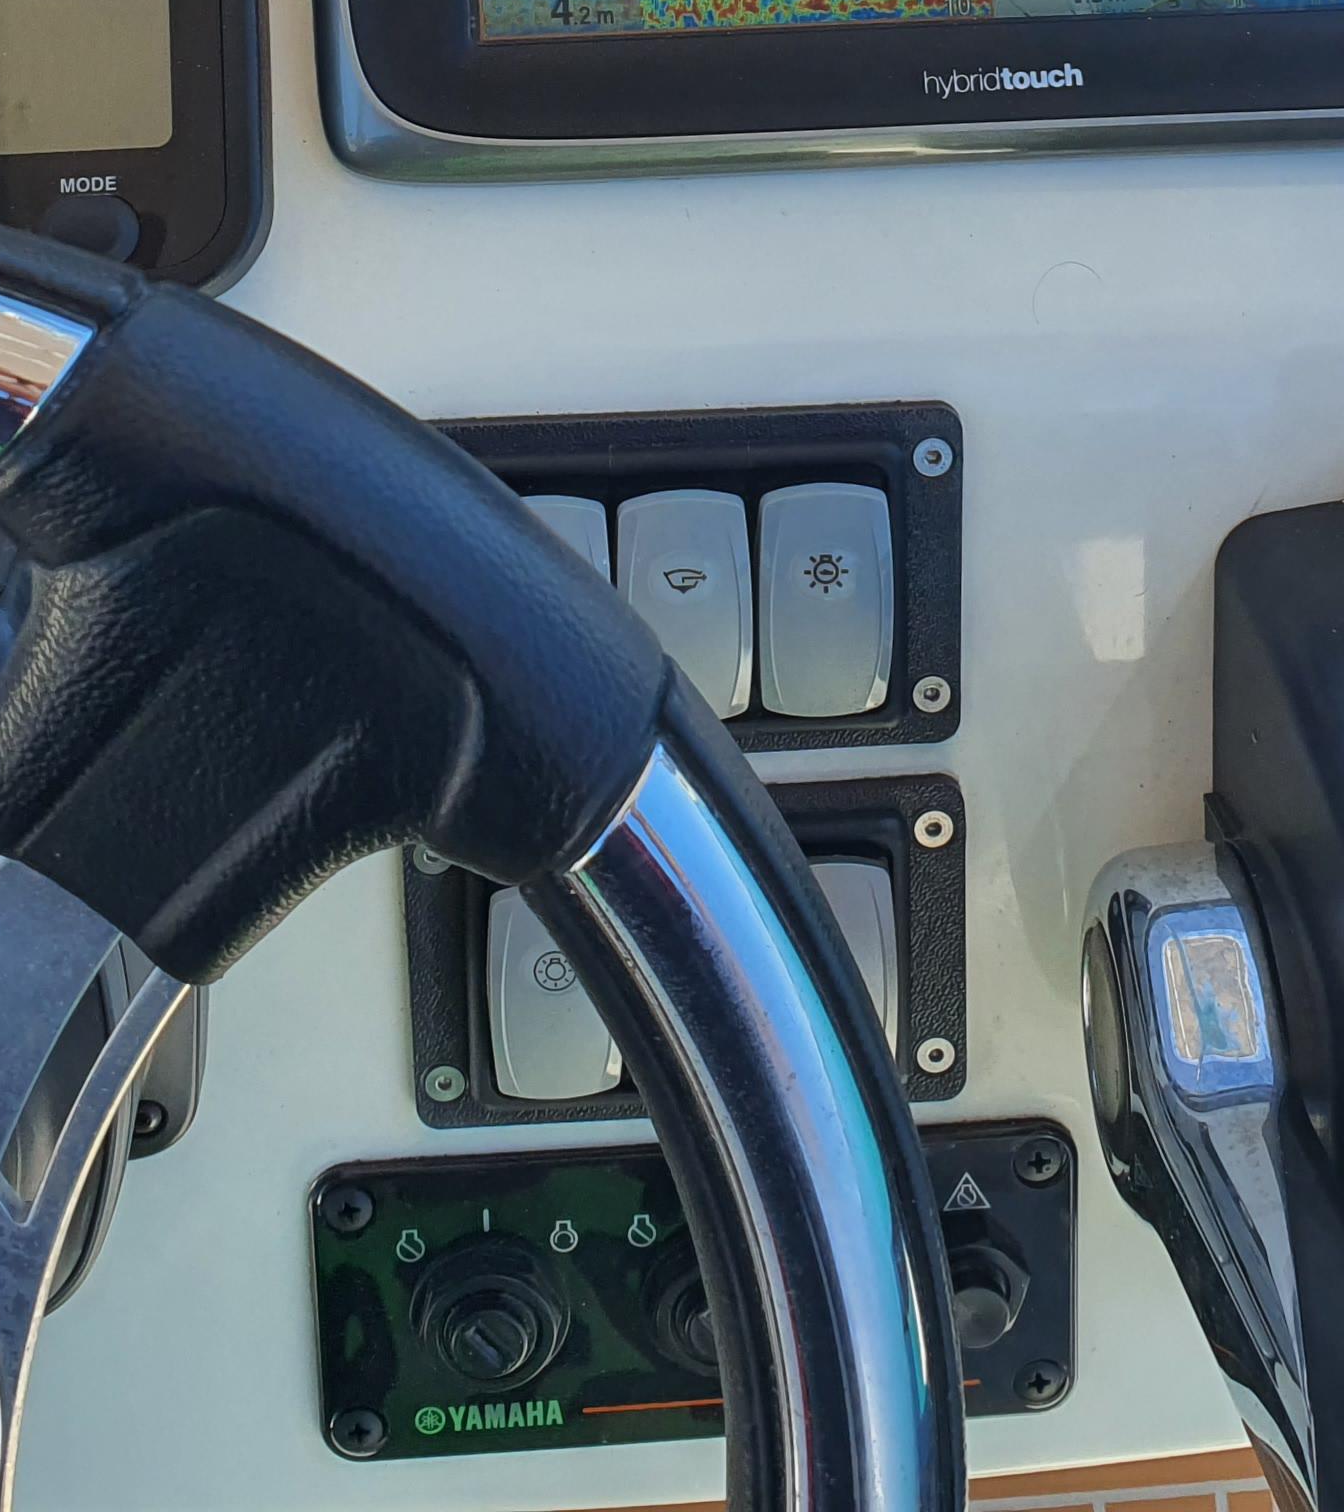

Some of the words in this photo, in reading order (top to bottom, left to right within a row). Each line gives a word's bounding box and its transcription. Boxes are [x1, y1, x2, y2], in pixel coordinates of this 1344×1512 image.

[923, 62, 1084, 100] hybridtouch
[60, 176, 117, 194] MODE
[447, 1400, 564, 1432] YAMAHA
